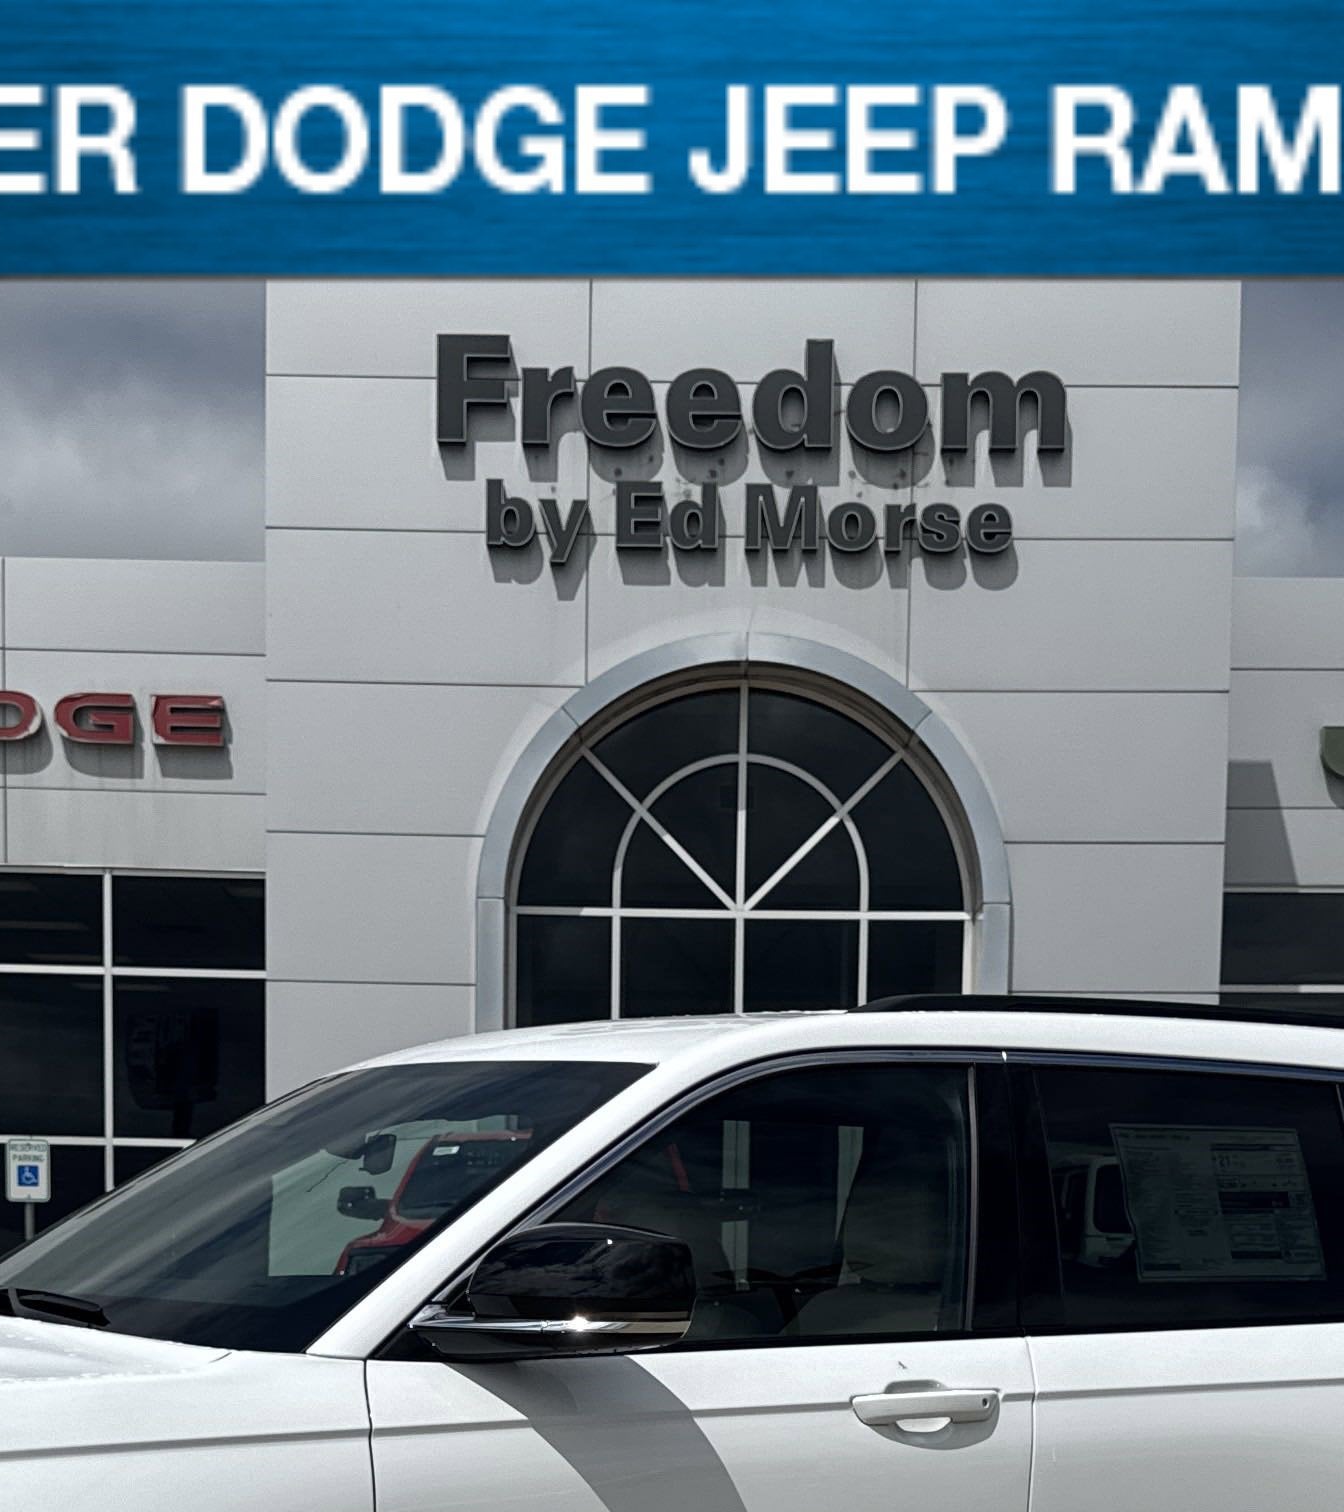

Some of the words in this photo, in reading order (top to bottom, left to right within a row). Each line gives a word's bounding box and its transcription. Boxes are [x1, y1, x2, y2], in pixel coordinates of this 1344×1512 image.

[436, 333, 1067, 453] Freedom
[486, 478, 587, 564] by
[616, 480, 720, 550] Ed
[744, 483, 1014, 553] Morse
[12, 1154, 45, 1162] PARKING
